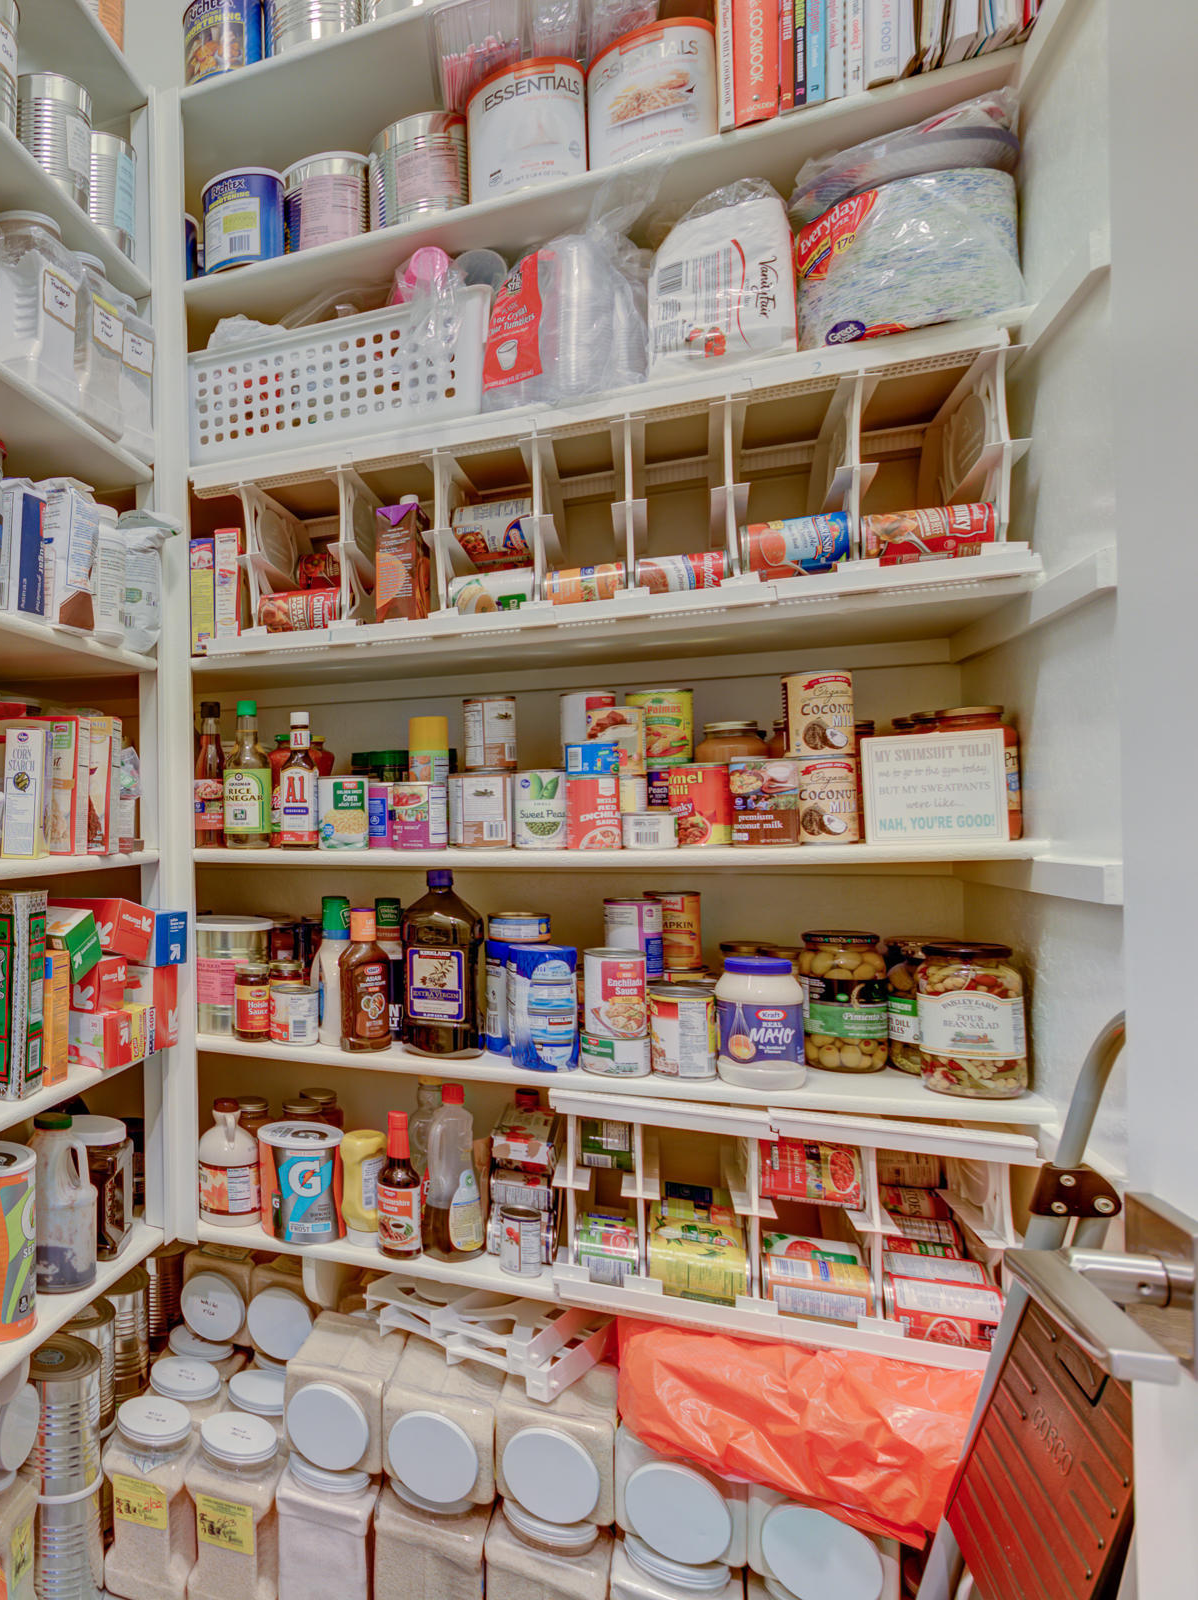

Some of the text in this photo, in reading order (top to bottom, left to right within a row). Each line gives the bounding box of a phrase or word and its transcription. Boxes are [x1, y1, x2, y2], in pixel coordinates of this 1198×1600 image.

[807, 0, 822, 33] etogenic
[881, 21, 892, 52] FOOD
[749, 9, 764, 85] COOKBOOK
[724, 60, 732, 105] COOKBOOK
[484, 75, 580, 112] ESSENTIALS
[211, 178, 246, 199] Richtex
[799, 195, 862, 256] Everyday
[835, 233, 855, 250] 170
[504, 313, 536, 331] Tumblers
[828, 323, 858, 343] Great
[838, 329, 862, 344] Value
[801, 703, 854, 716] COCONUT
[832, 715, 854, 728] MIL
[12, 748, 32, 760] CORN
[874, 742, 992, 763] MY SWIMSUIT TOLD
[7, 760, 35, 773] STARCH
[669, 771, 703, 785] rmel
[648, 786, 668, 794] Peach
[799, 788, 857, 801] COCONUT
[878, 780, 992, 796] BUT MY SWEATPANTS
[342, 794, 358, 802] Corn
[905, 800, 932, 809] were
[520, 809, 567, 818] Sweet Peas
[579, 811, 621, 822] ENCHILA
[738, 812, 774, 822] premium
[762, 820, 784, 829] milk
[878, 813, 995, 832] NAH, YOU'RE GOOD!
[663, 920, 694, 929] MPKIN
[607, 978, 643, 987] Enchilada
[413, 990, 459, 999] EXTRA VIRGIN
[615, 986, 638, 996] Sauce
[248, 1001, 268, 1009] Hoisin
[895, 1018, 910, 1028] DILL
[942, 1019, 1000, 1030] BEAN SALAD
[957, 1014, 985, 1023] FOUR
[749, 1027, 796, 1045] MAYO
[288, 1160, 321, 1198] G
[290, 1224, 311, 1233] FROST
[1031, 1406, 1074, 1477] COSCO
